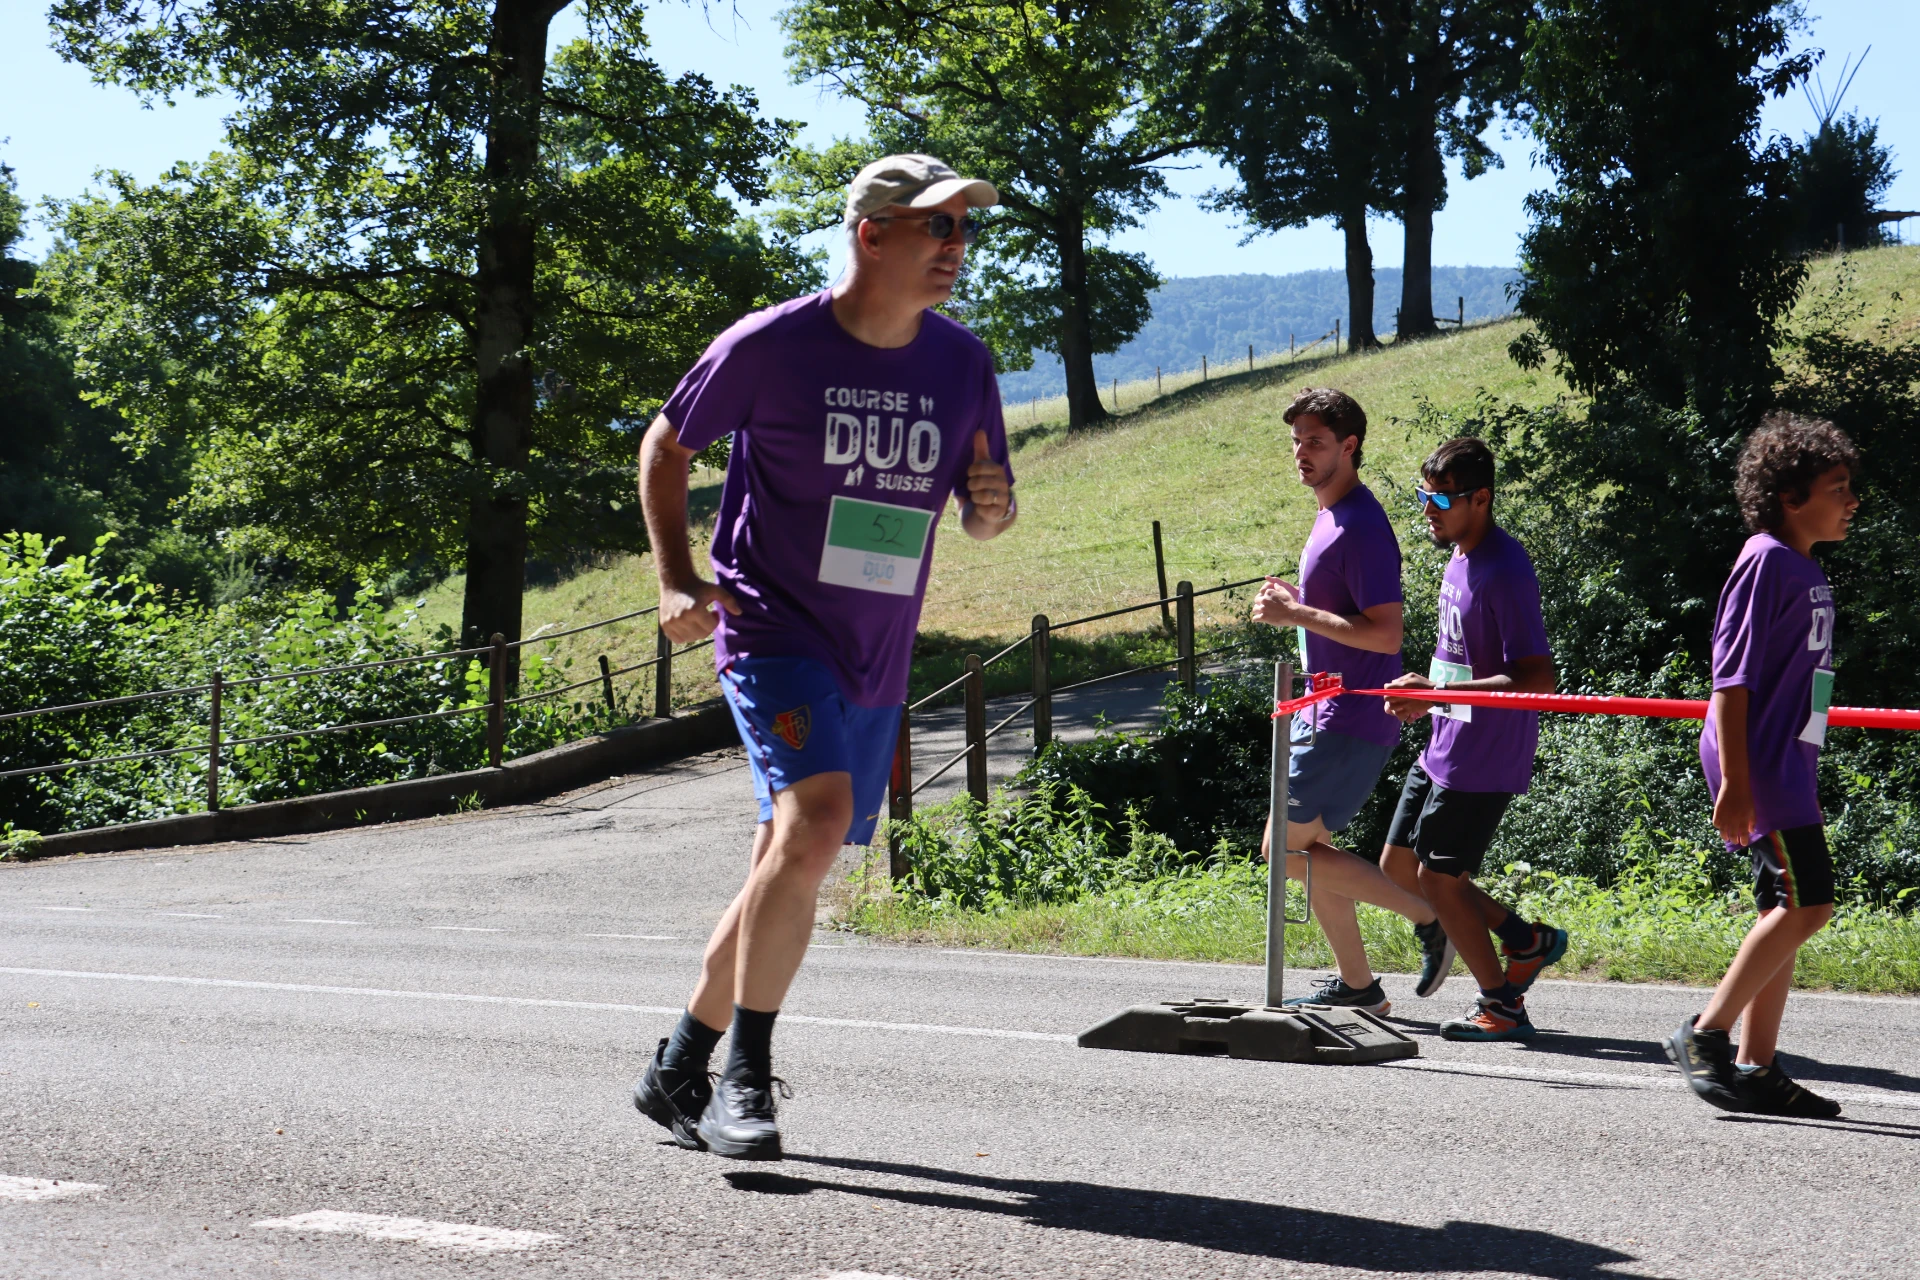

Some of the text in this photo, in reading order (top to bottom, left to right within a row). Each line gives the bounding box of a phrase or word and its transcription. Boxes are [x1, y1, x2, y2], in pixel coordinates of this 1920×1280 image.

[824, 387, 909, 412] COURSE
[823, 412, 941, 474] DUO
[875, 472, 935, 493] SUISSE
[870, 513, 905, 548] 52
[862, 560, 896, 581] DUO
[1438, 597, 1463, 641] UO
[1436, 664, 1458, 683] 27
